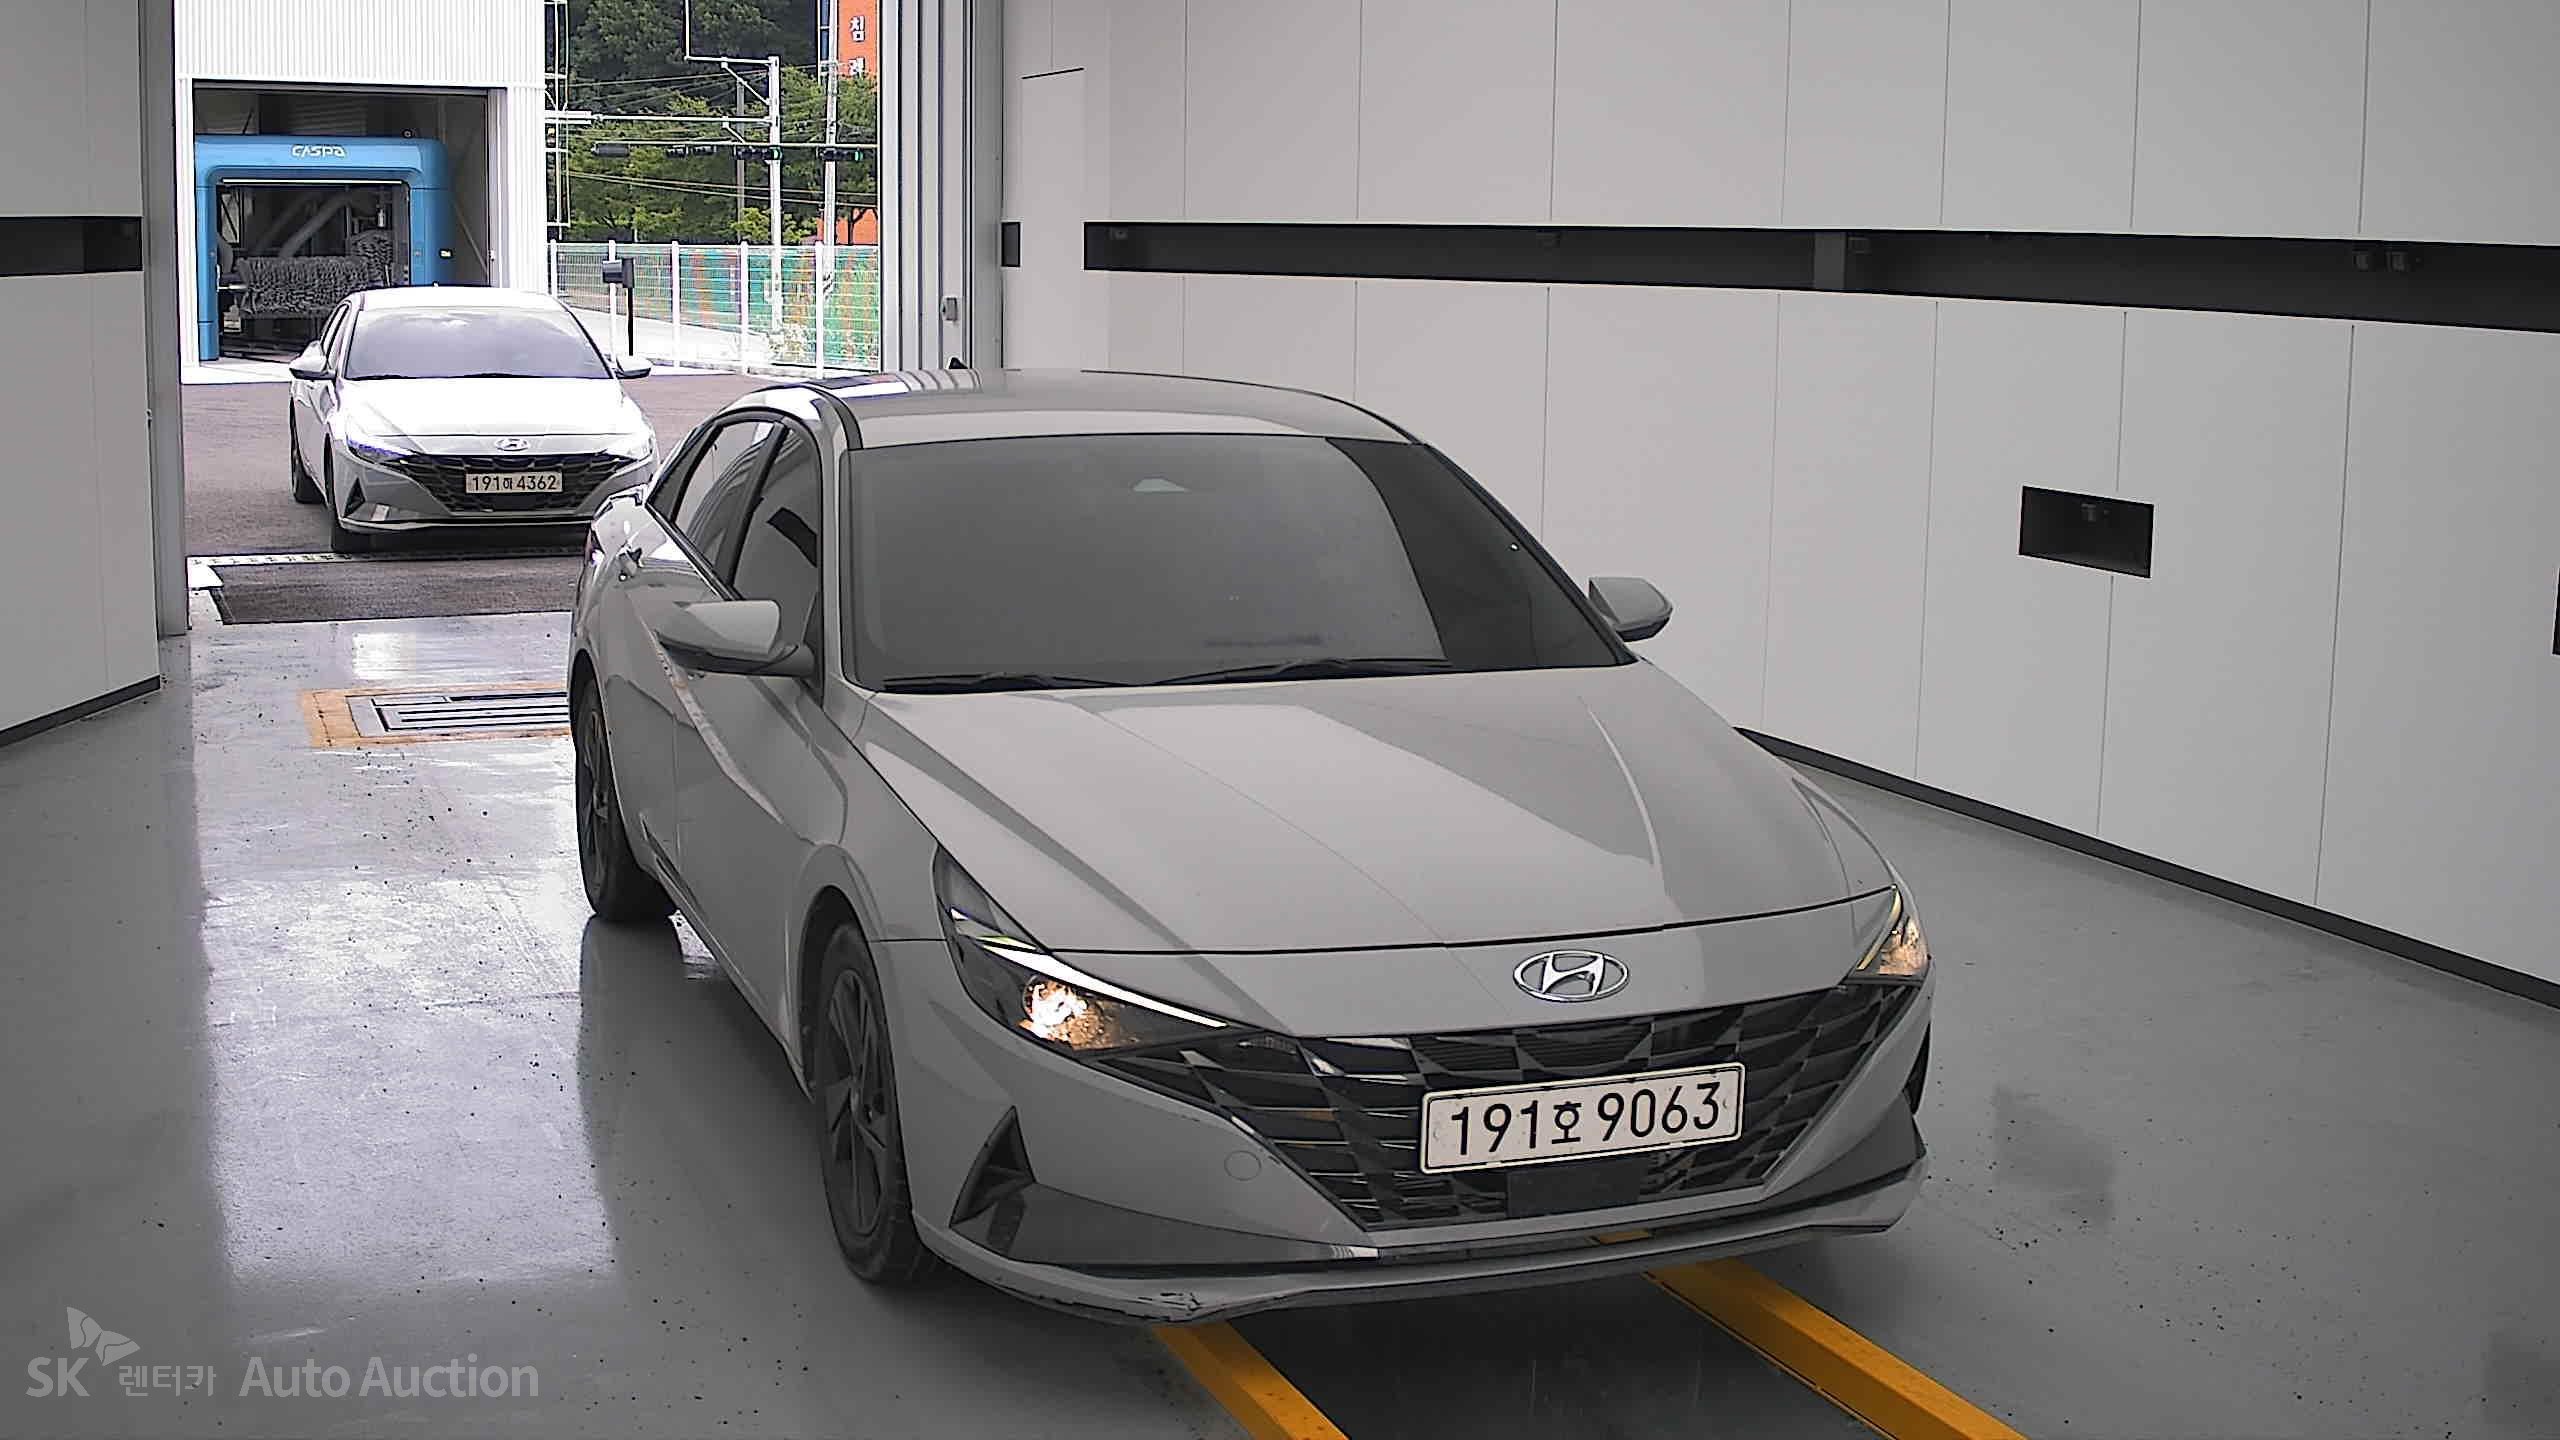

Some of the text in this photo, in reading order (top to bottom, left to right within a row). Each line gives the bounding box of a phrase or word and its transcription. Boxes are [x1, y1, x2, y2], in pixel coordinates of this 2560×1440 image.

[516, 474, 557, 490] 4362
[1450, 1081, 1722, 1156] 191호 9063
